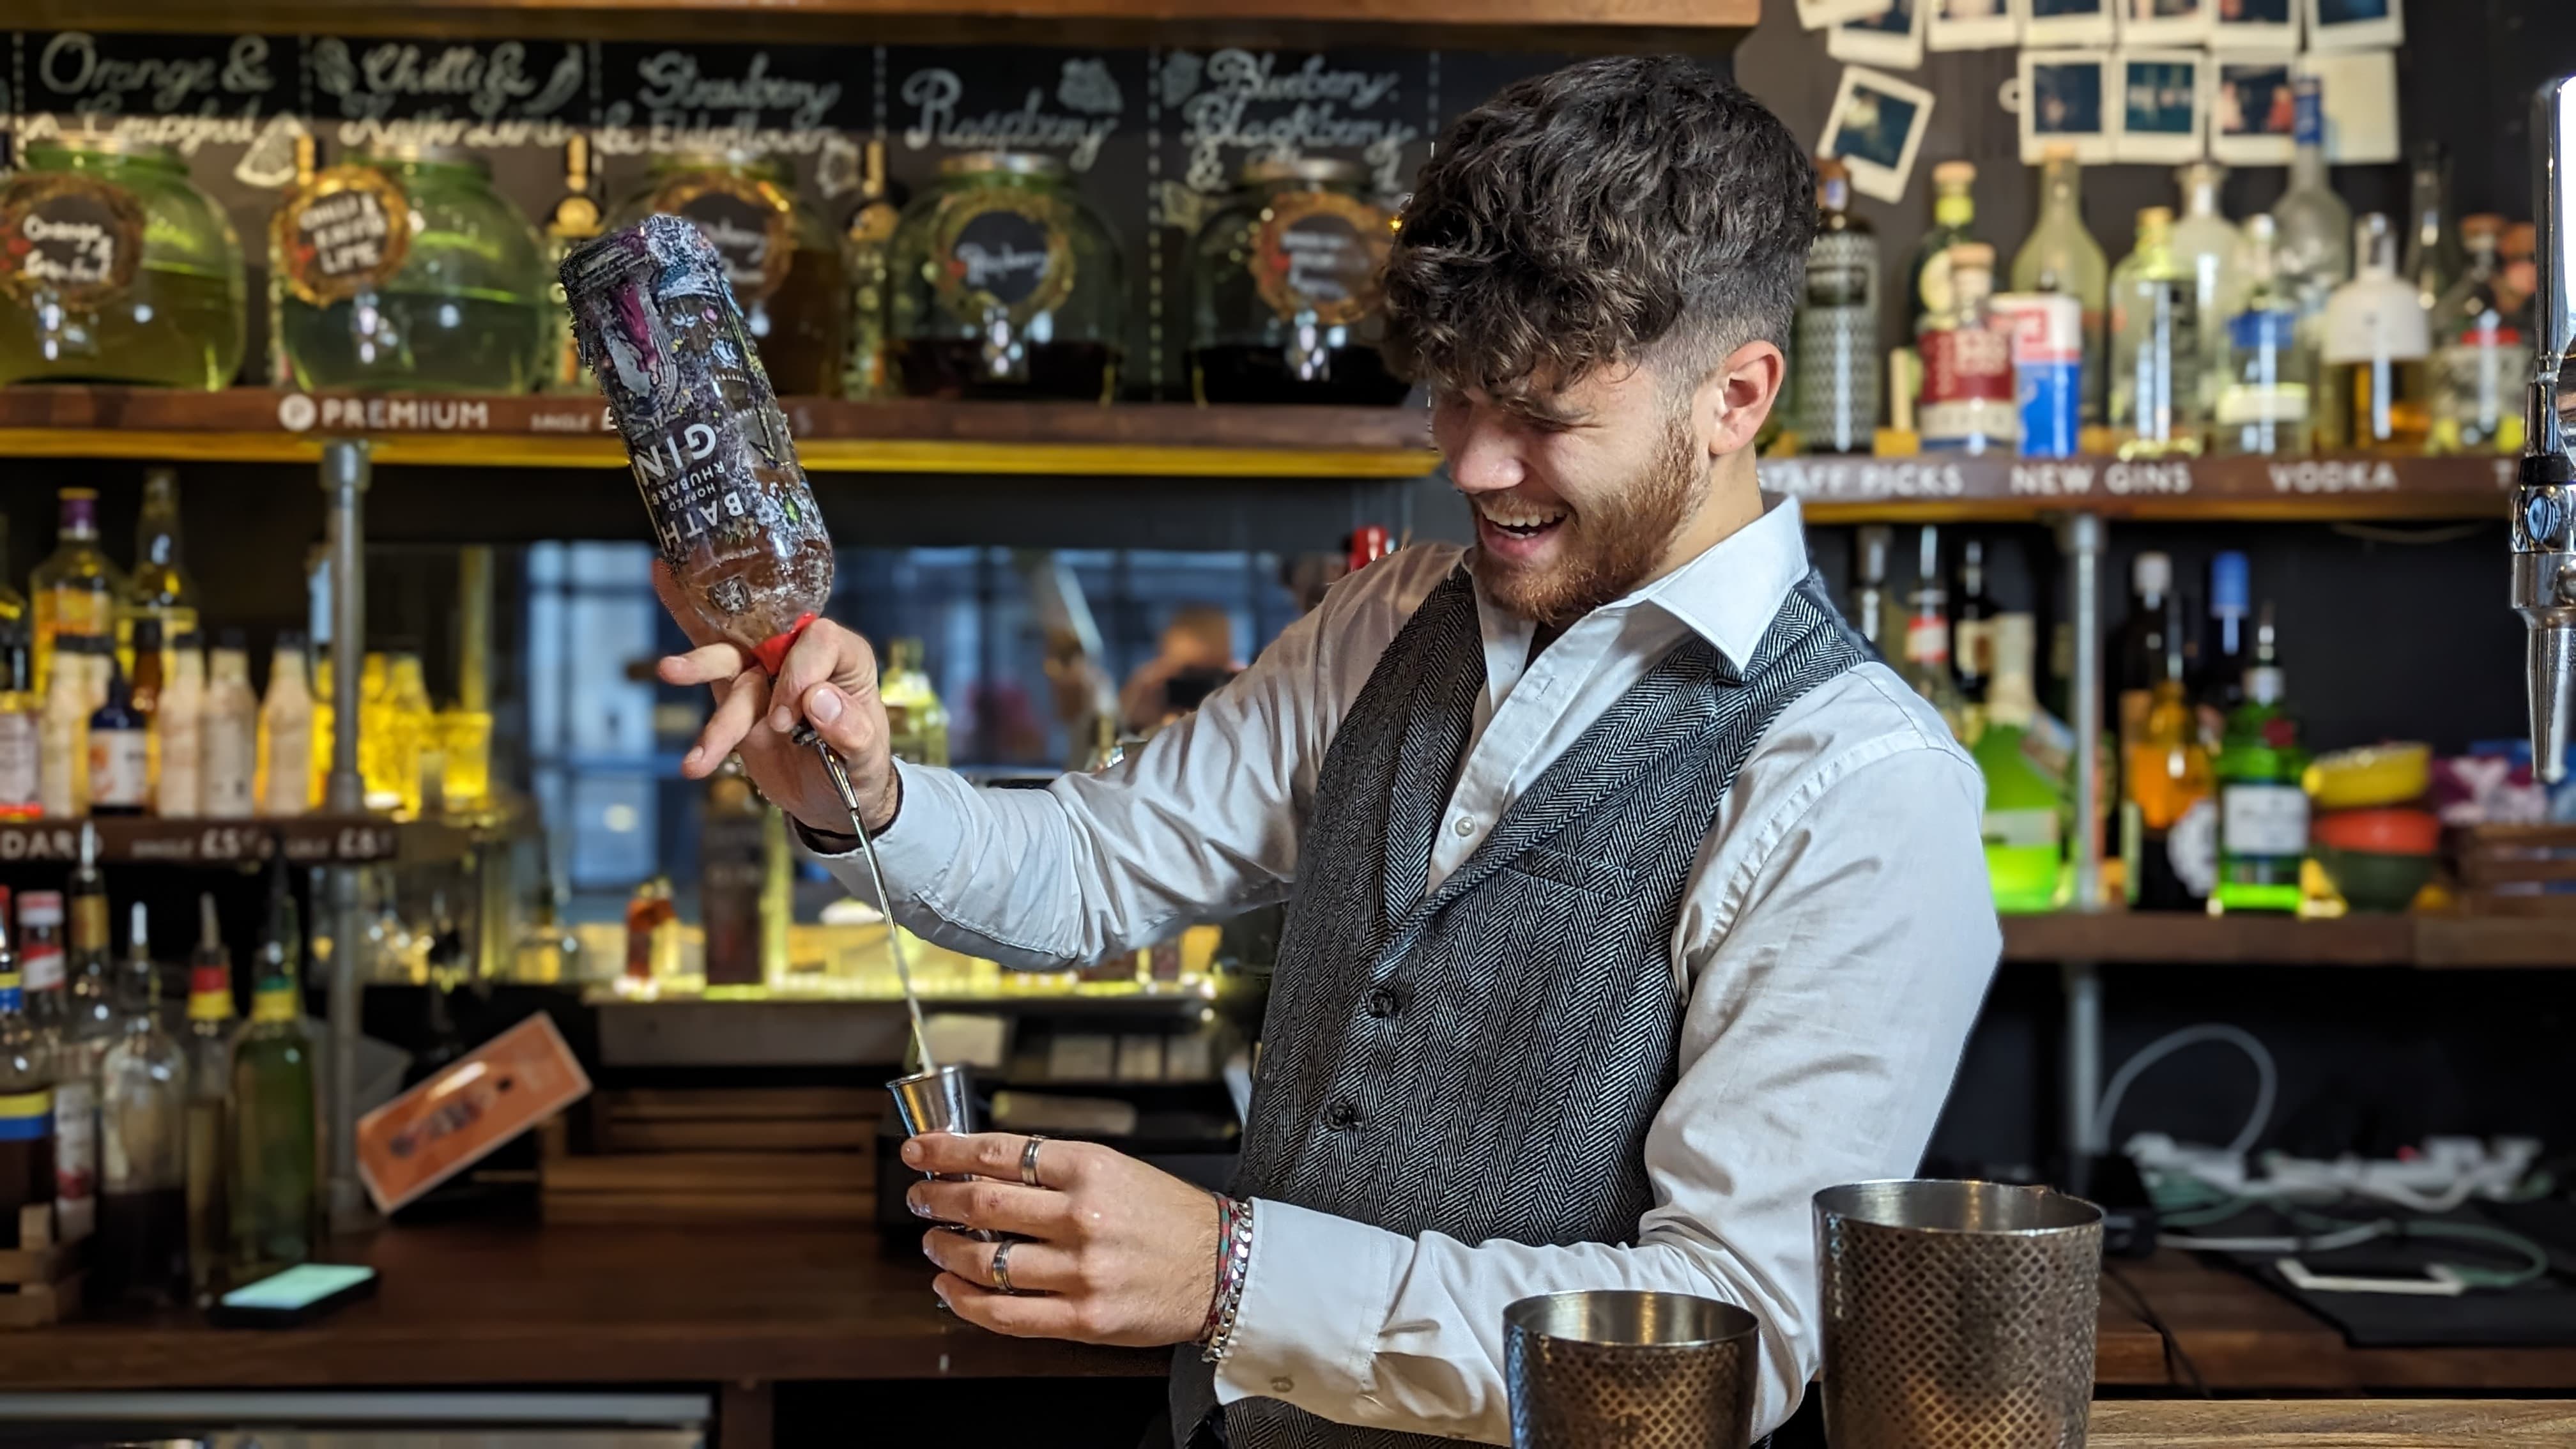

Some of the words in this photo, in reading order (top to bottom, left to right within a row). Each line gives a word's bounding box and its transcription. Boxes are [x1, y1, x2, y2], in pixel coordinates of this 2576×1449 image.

[40, 32, 217, 111] Orange
[221, 34, 276, 93] &
[901, 68, 1119, 172] Raspberry
[322, 399, 489, 429] PREMIUM
[634, 423, 717, 487] GIN
[652, 460, 726, 506] RHUBARB
[1856, 464, 1965, 496] PICKS
[2010, 464, 2095, 494] NEW
[2104, 463, 2191, 494] GINS
[2269, 461, 2396, 493] VODKA
[669, 482, 716, 512] HOPPED
[661, 491, 745, 549] BATH
